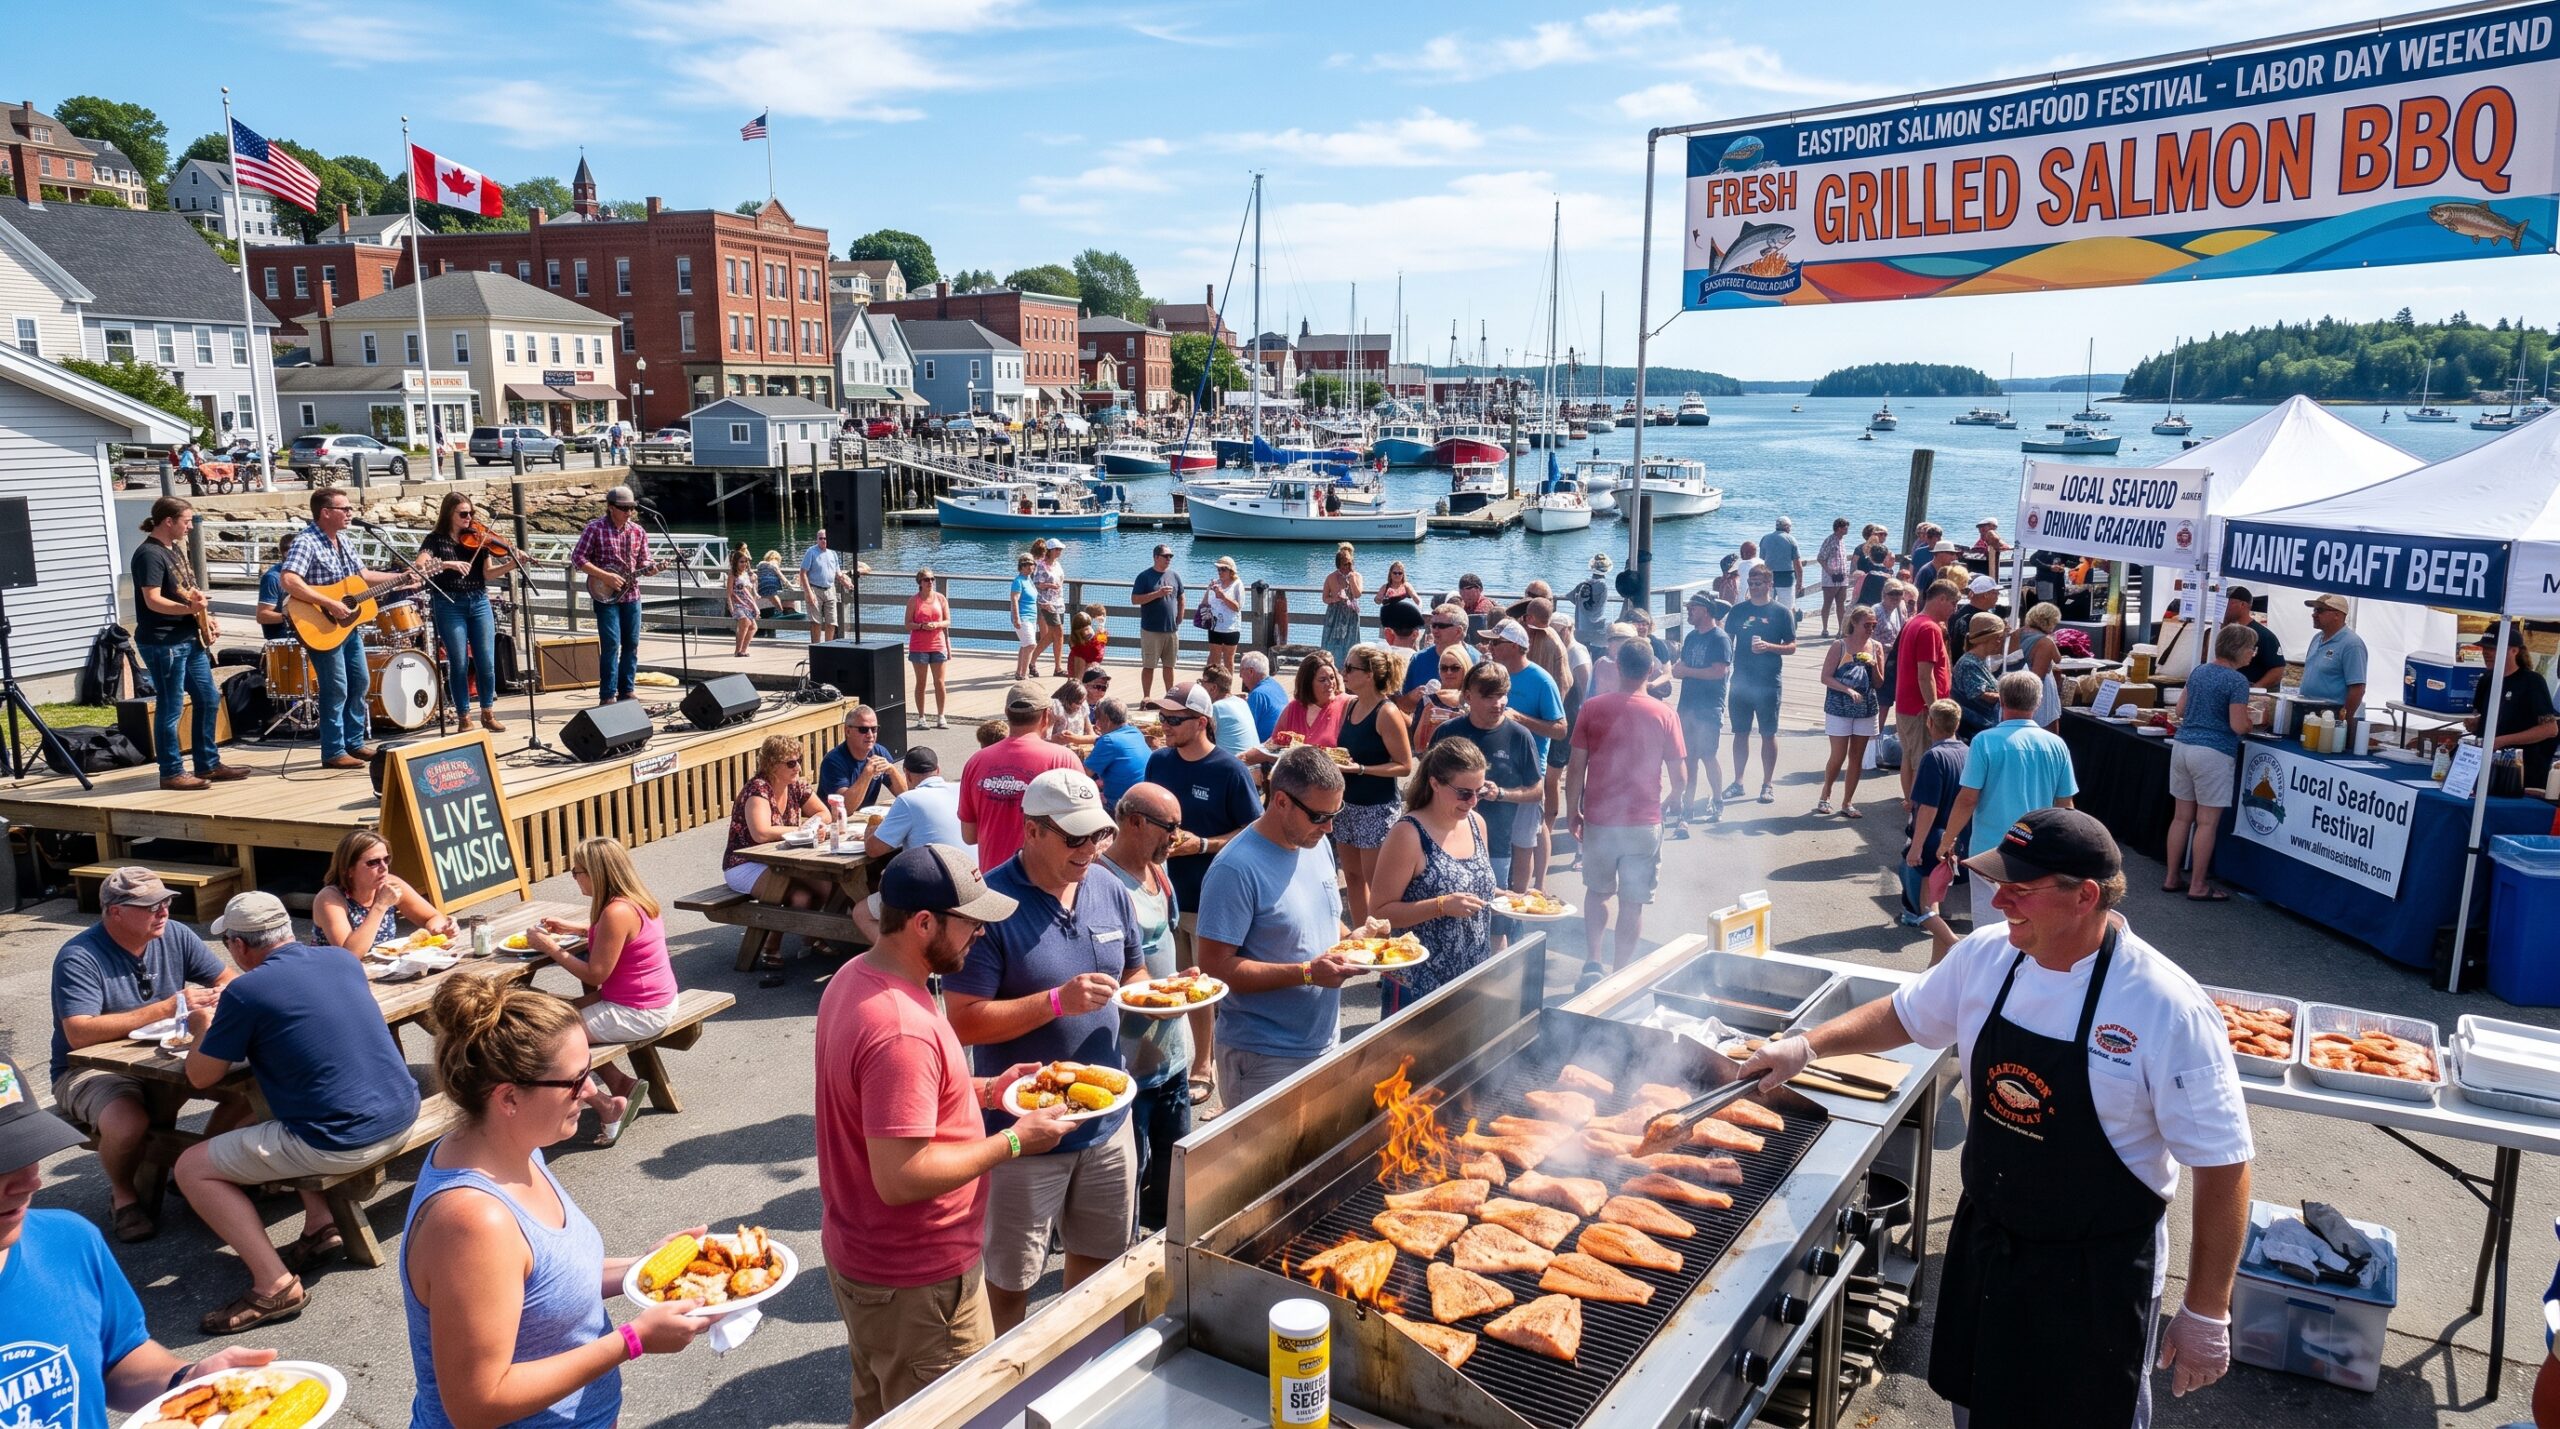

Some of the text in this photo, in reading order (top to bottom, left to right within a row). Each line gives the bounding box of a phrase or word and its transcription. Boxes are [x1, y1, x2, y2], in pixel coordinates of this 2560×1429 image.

[1798, 120, 1893, 157] EASTPORT
[1897, 107, 1982, 145] SALMON
[1988, 92, 2089, 132] SEAFOOD
[2096, 73, 2208, 118] FESTIVAL
[2235, 54, 2325, 98] LABOR
[2333, 42, 2392, 82] DAY
[2399, 16, 2553, 72] WEEKEND
[1707, 170, 1797, 218] FRESH
[1814, 85, 2517, 245] GRILLED SALMON BBQ
[2060, 475, 2178, 510] LOCAL SEAFOOD
[2231, 532, 2490, 599] MAINE CRAFT BEER
[425, 793, 493, 843] LIVE
[2290, 766, 2333, 802] Local
[2337, 780, 2409, 826] Seafood
[2311, 805, 2375, 850] Festival
[434, 832, 511, 890] MUSIC
